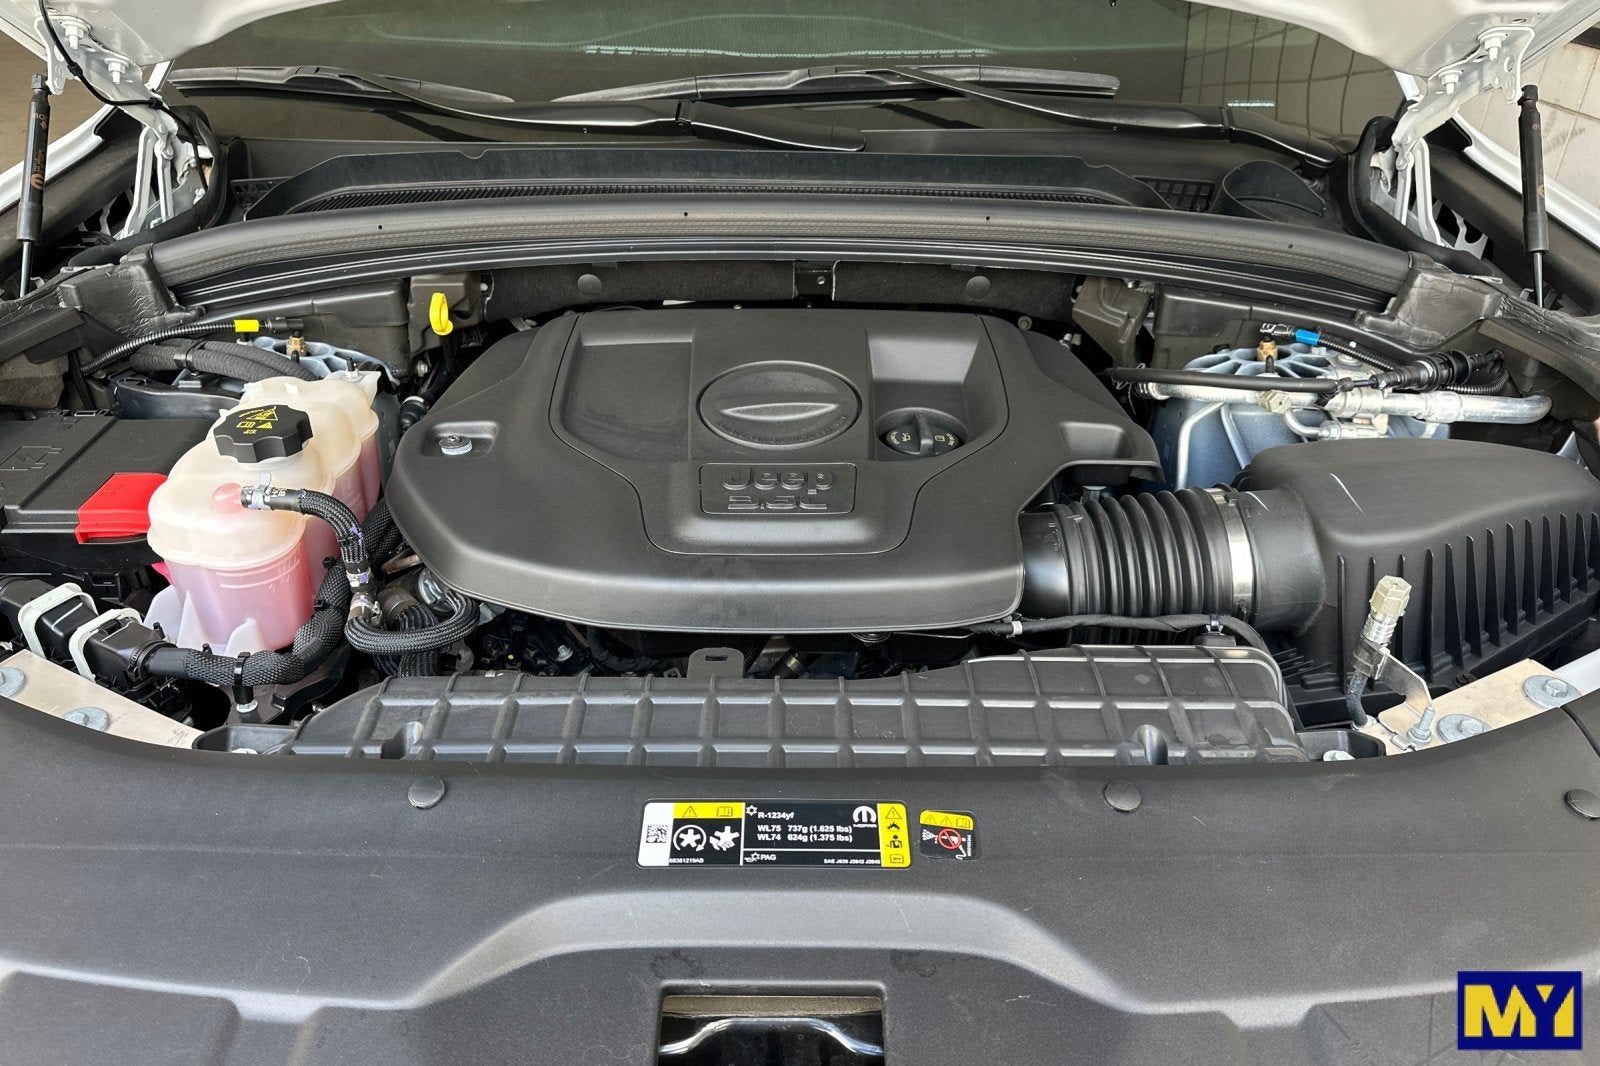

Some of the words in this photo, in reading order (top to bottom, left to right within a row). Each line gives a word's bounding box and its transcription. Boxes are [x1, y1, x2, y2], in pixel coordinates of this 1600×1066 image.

[722, 466, 834, 495] Jeep
[757, 812, 795, 820] R-1234yf
[787, 825, 808, 834] 737g
[809, 825, 835, 834] (1.625
[836, 825, 853, 834] lbs)
[787, 834, 808, 843] 624g
[809, 834, 835, 843] (1.375
[836, 834, 853, 843] lbs)
